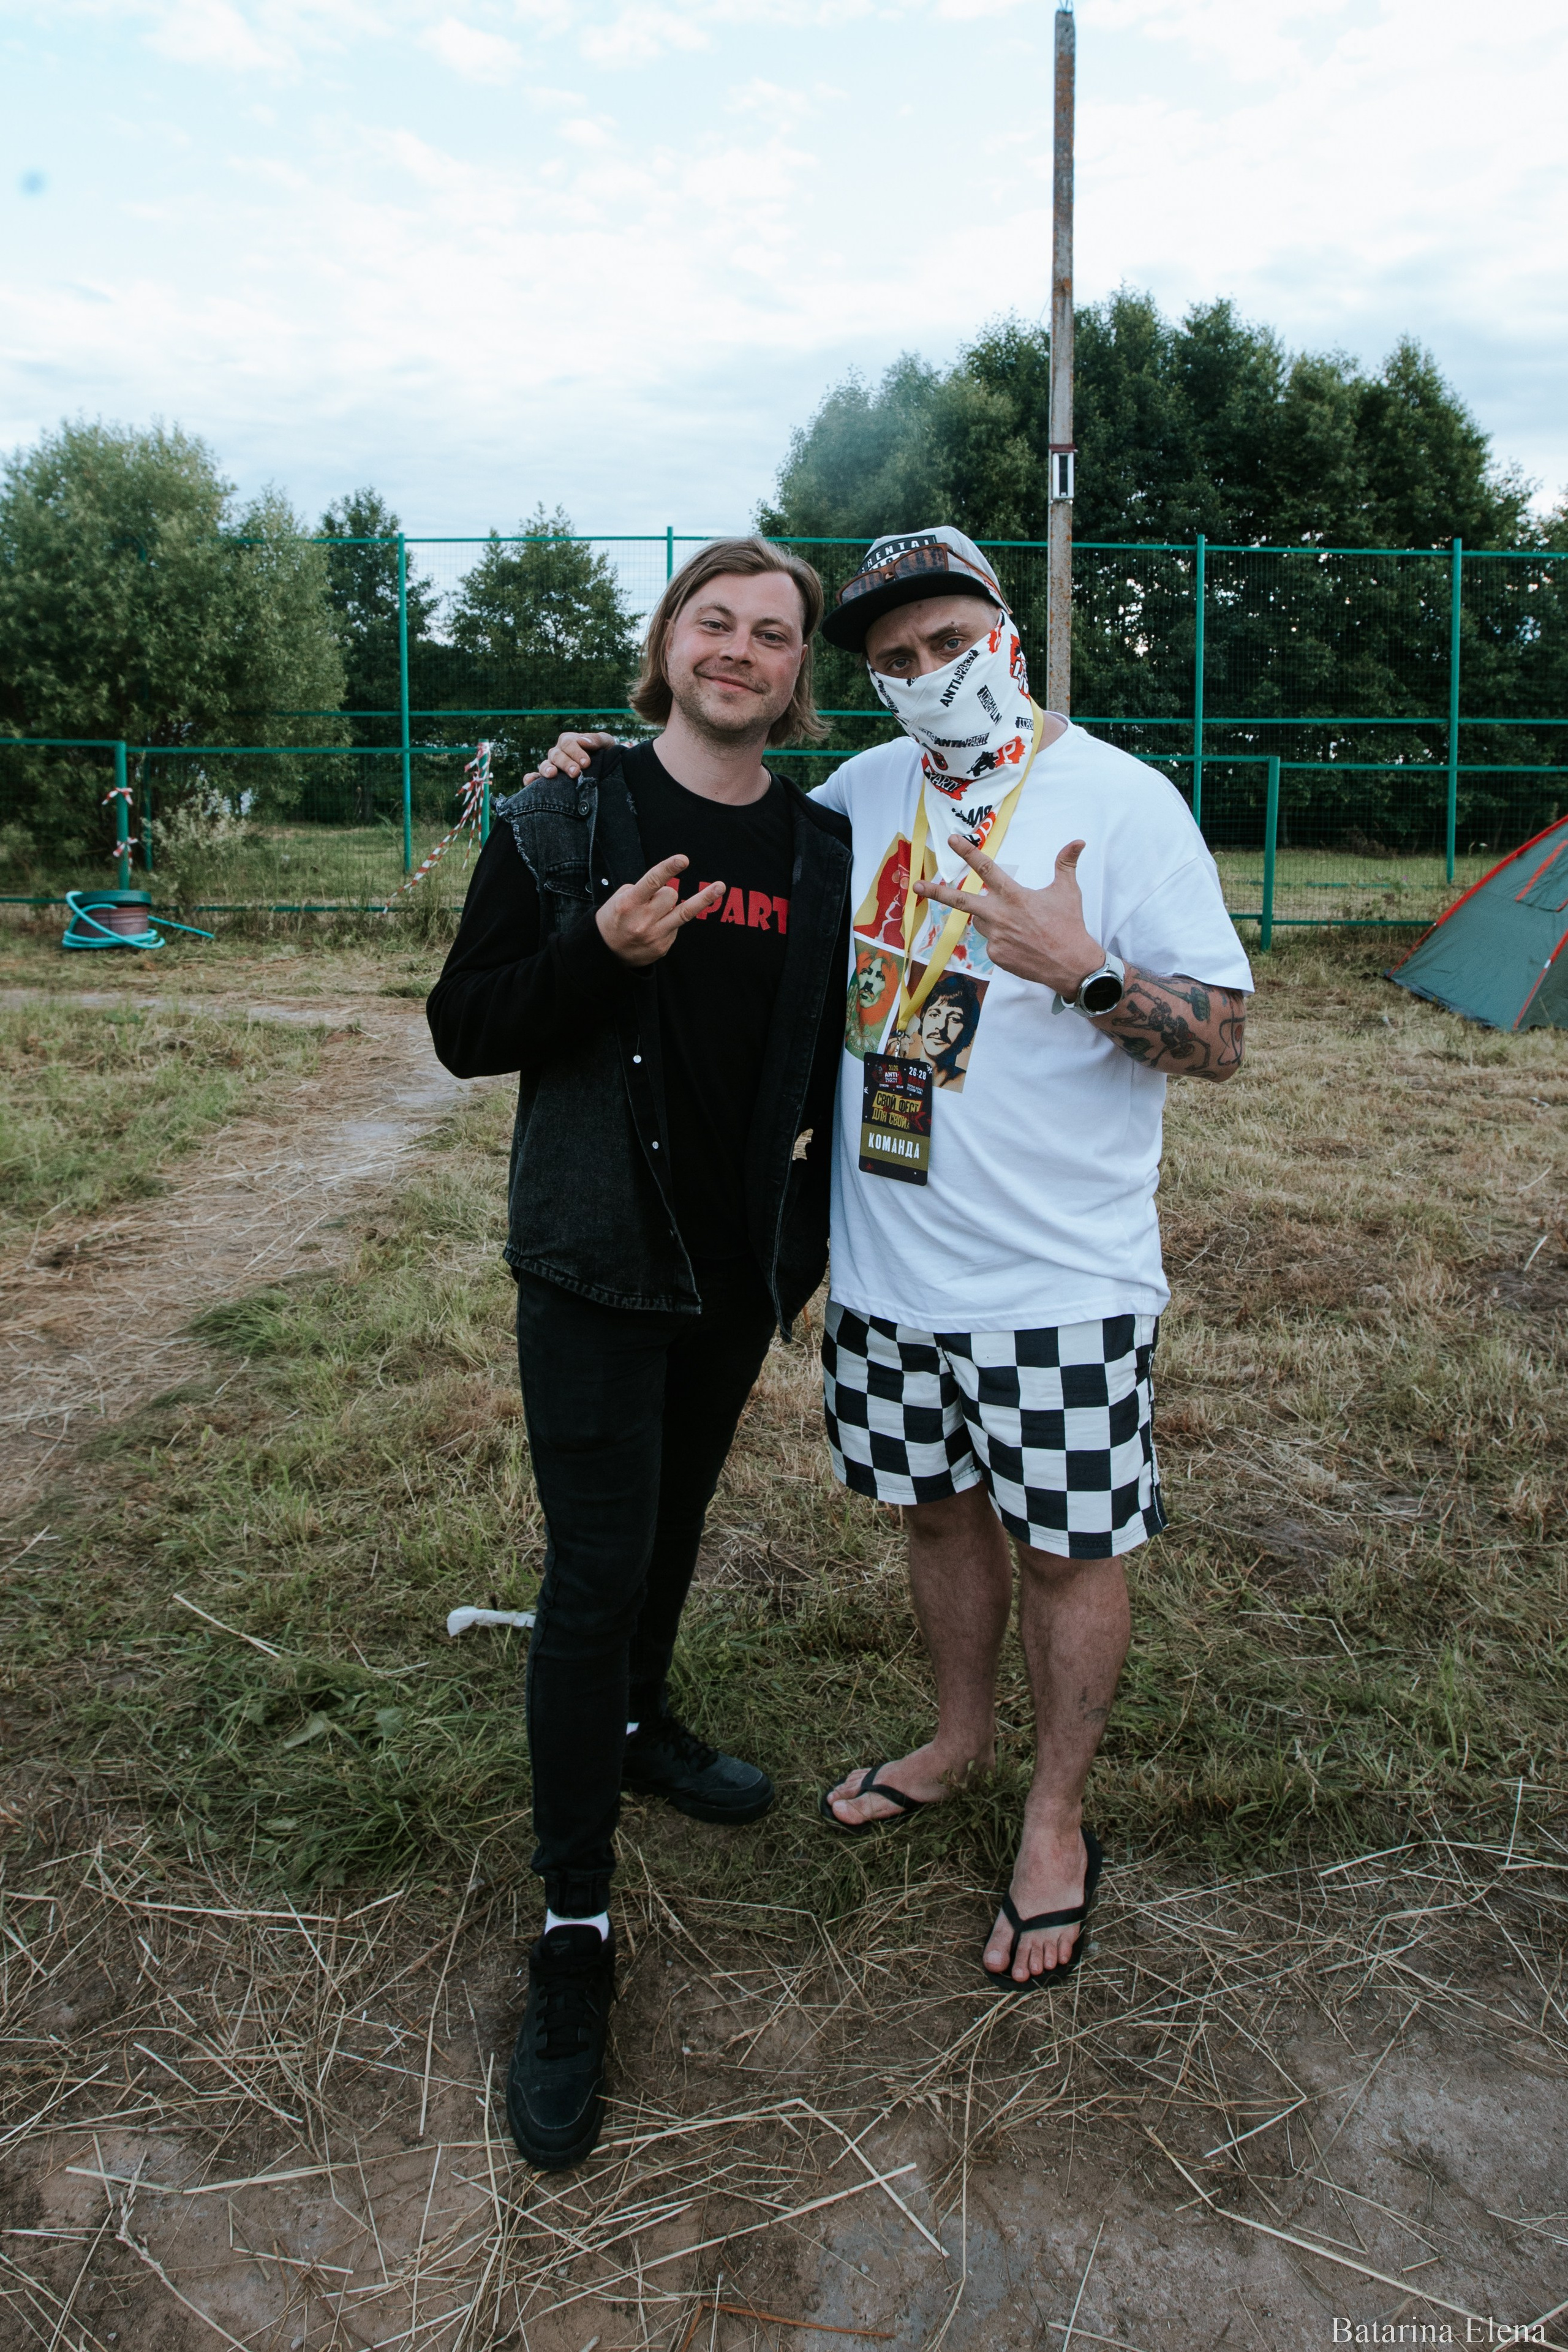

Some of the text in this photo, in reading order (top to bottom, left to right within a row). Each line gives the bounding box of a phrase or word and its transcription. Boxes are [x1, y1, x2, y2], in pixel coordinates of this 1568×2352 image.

[876, 1092, 919, 1114] СВОЙ ФЕСТ
[872, 1108, 887, 1123] ДЛЯ
[869, 1133, 919, 1159] КОМАНДА
